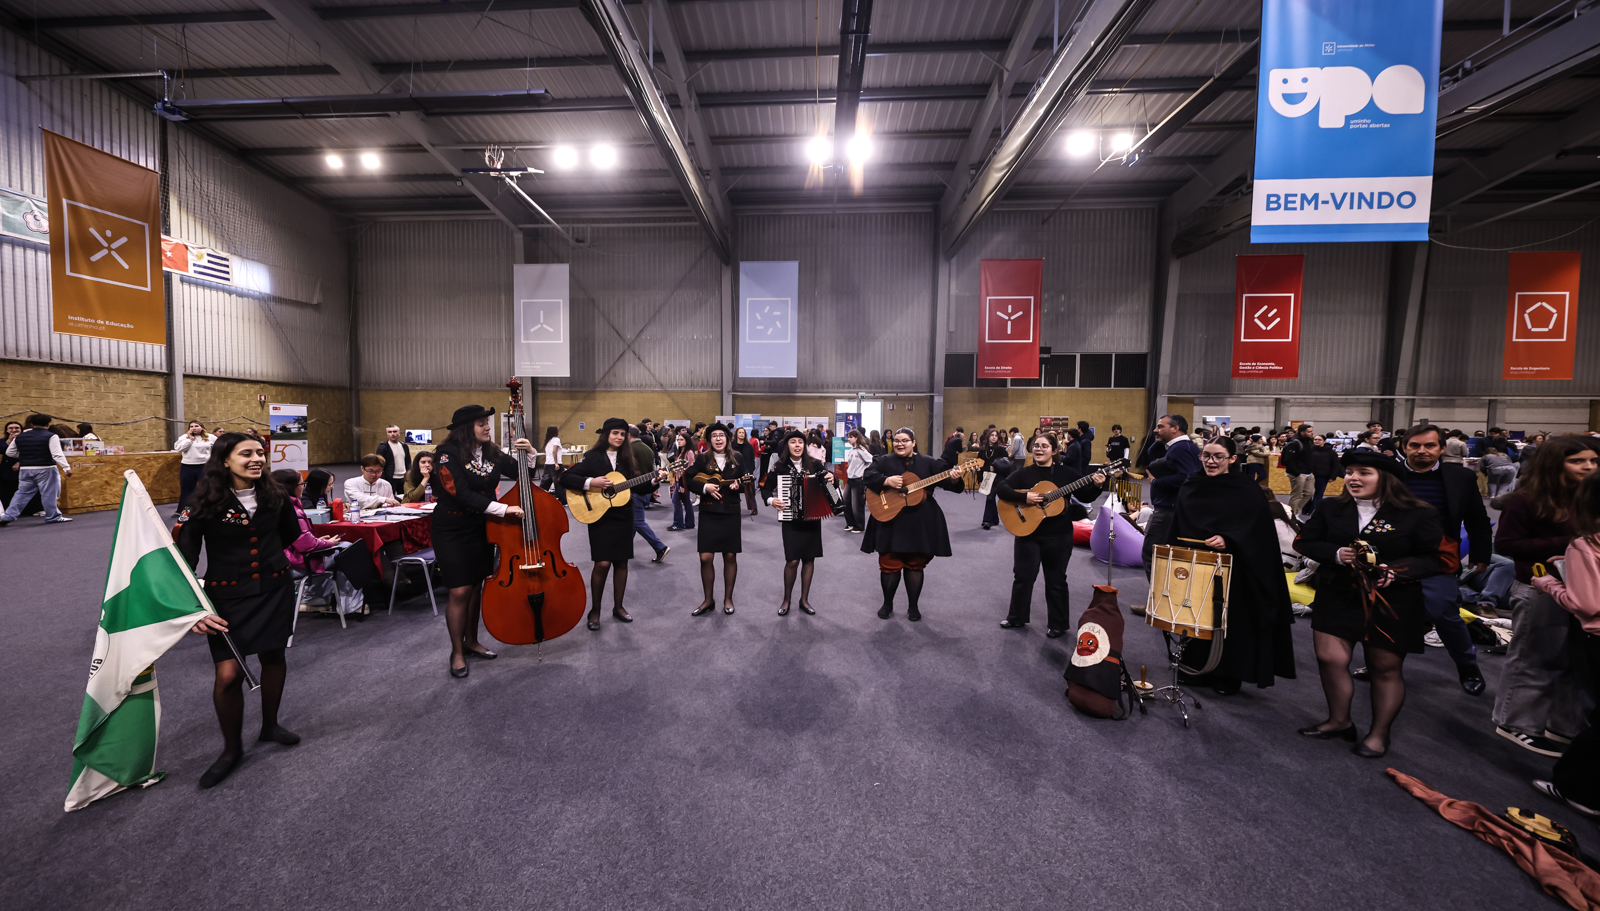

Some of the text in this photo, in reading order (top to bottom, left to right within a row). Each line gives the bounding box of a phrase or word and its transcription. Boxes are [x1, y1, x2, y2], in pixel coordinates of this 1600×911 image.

[1266, 190, 1416, 211] BEM-VINDO
[68, 315, 95, 323] Instituto
[106, 320, 134, 328] Educação
[272, 444, 302, 463] 50
